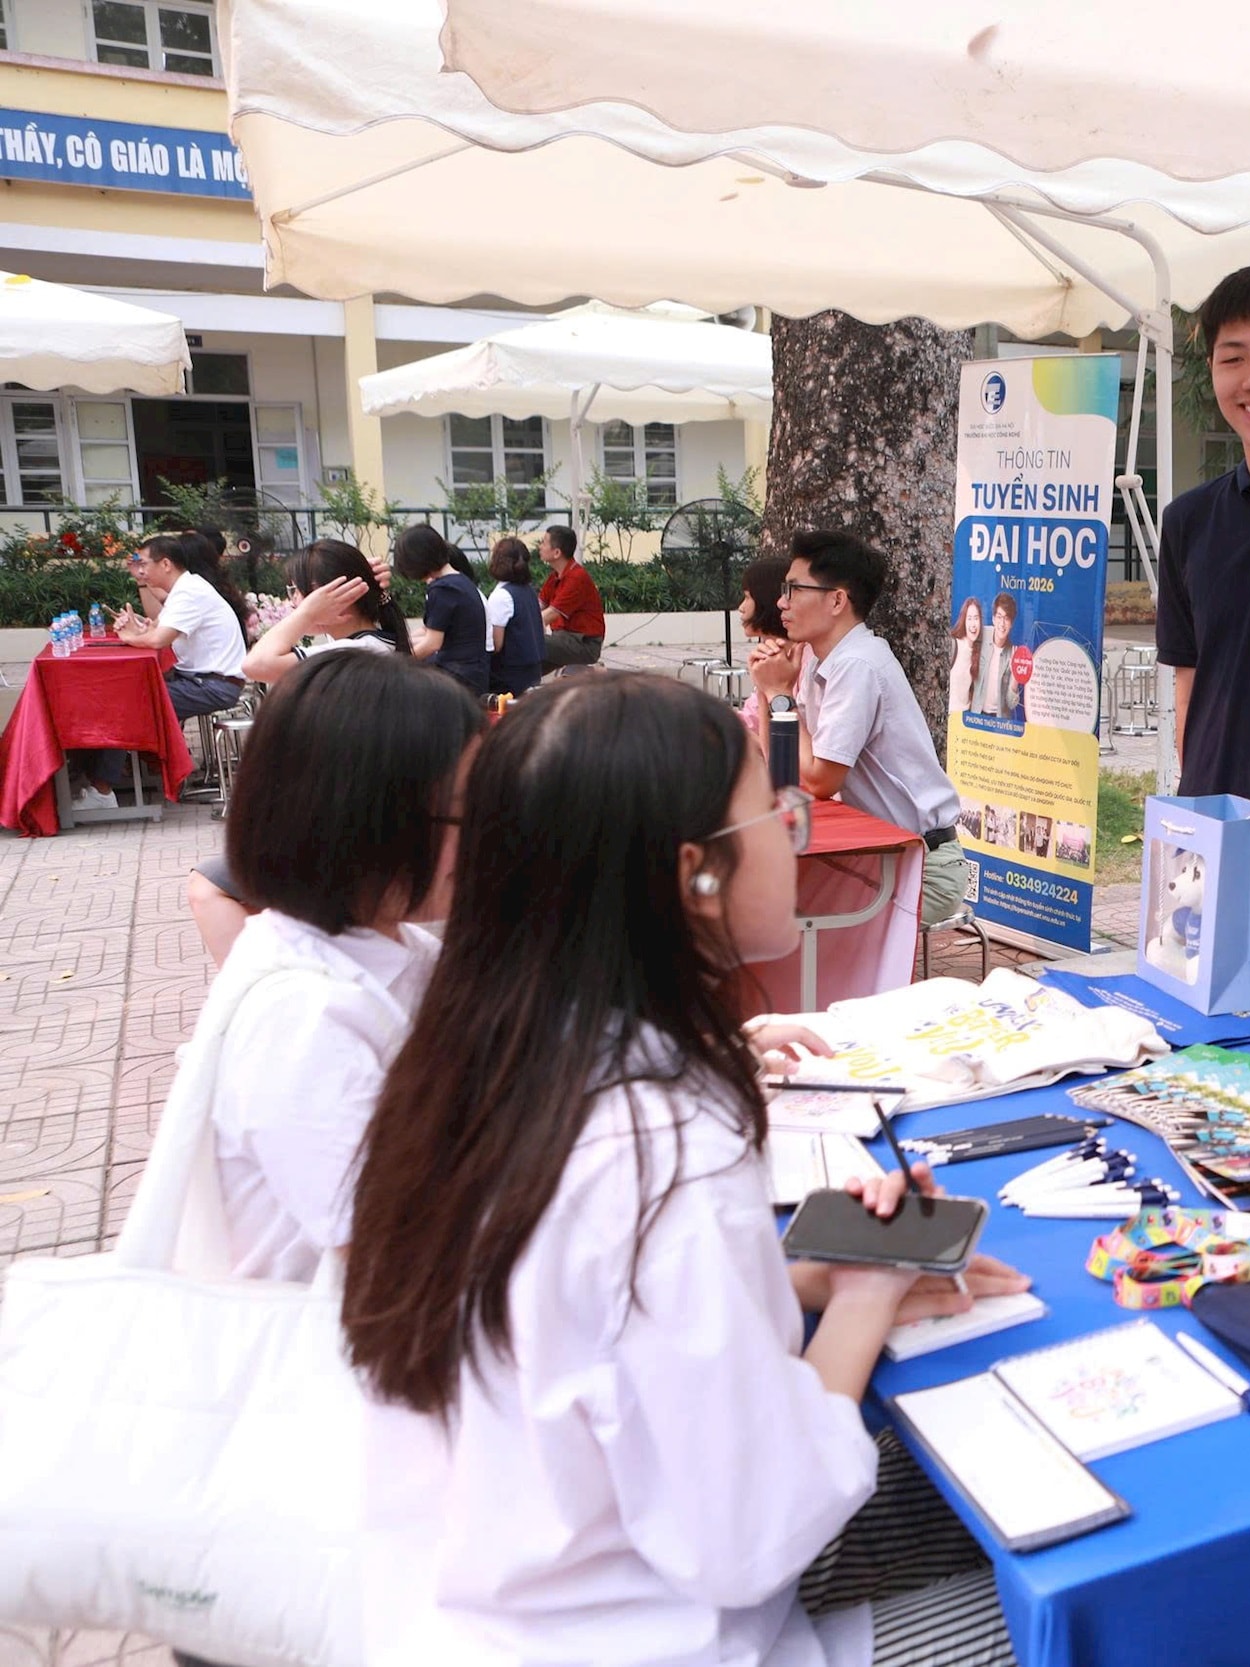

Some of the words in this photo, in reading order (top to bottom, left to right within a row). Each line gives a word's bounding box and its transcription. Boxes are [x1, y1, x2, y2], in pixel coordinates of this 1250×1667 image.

[66, 131, 103, 170] CÔ
[110, 137, 170, 177] GIÁO
[177, 142, 207, 180] LÀ
[997, 447, 1044, 470] THÔNG
[1048, 450, 1071, 469] TIN
[971, 474, 1038, 511] TUYỂN
[1042, 483, 1100, 512] SINH
[969, 523, 1020, 573] ĐẠI
[1027, 526, 1097, 577] HỌC
[1001, 574, 1027, 591] Năm
[1028, 576, 1055, 592] 2026
[1006, 871, 1079, 905] 0334924224
